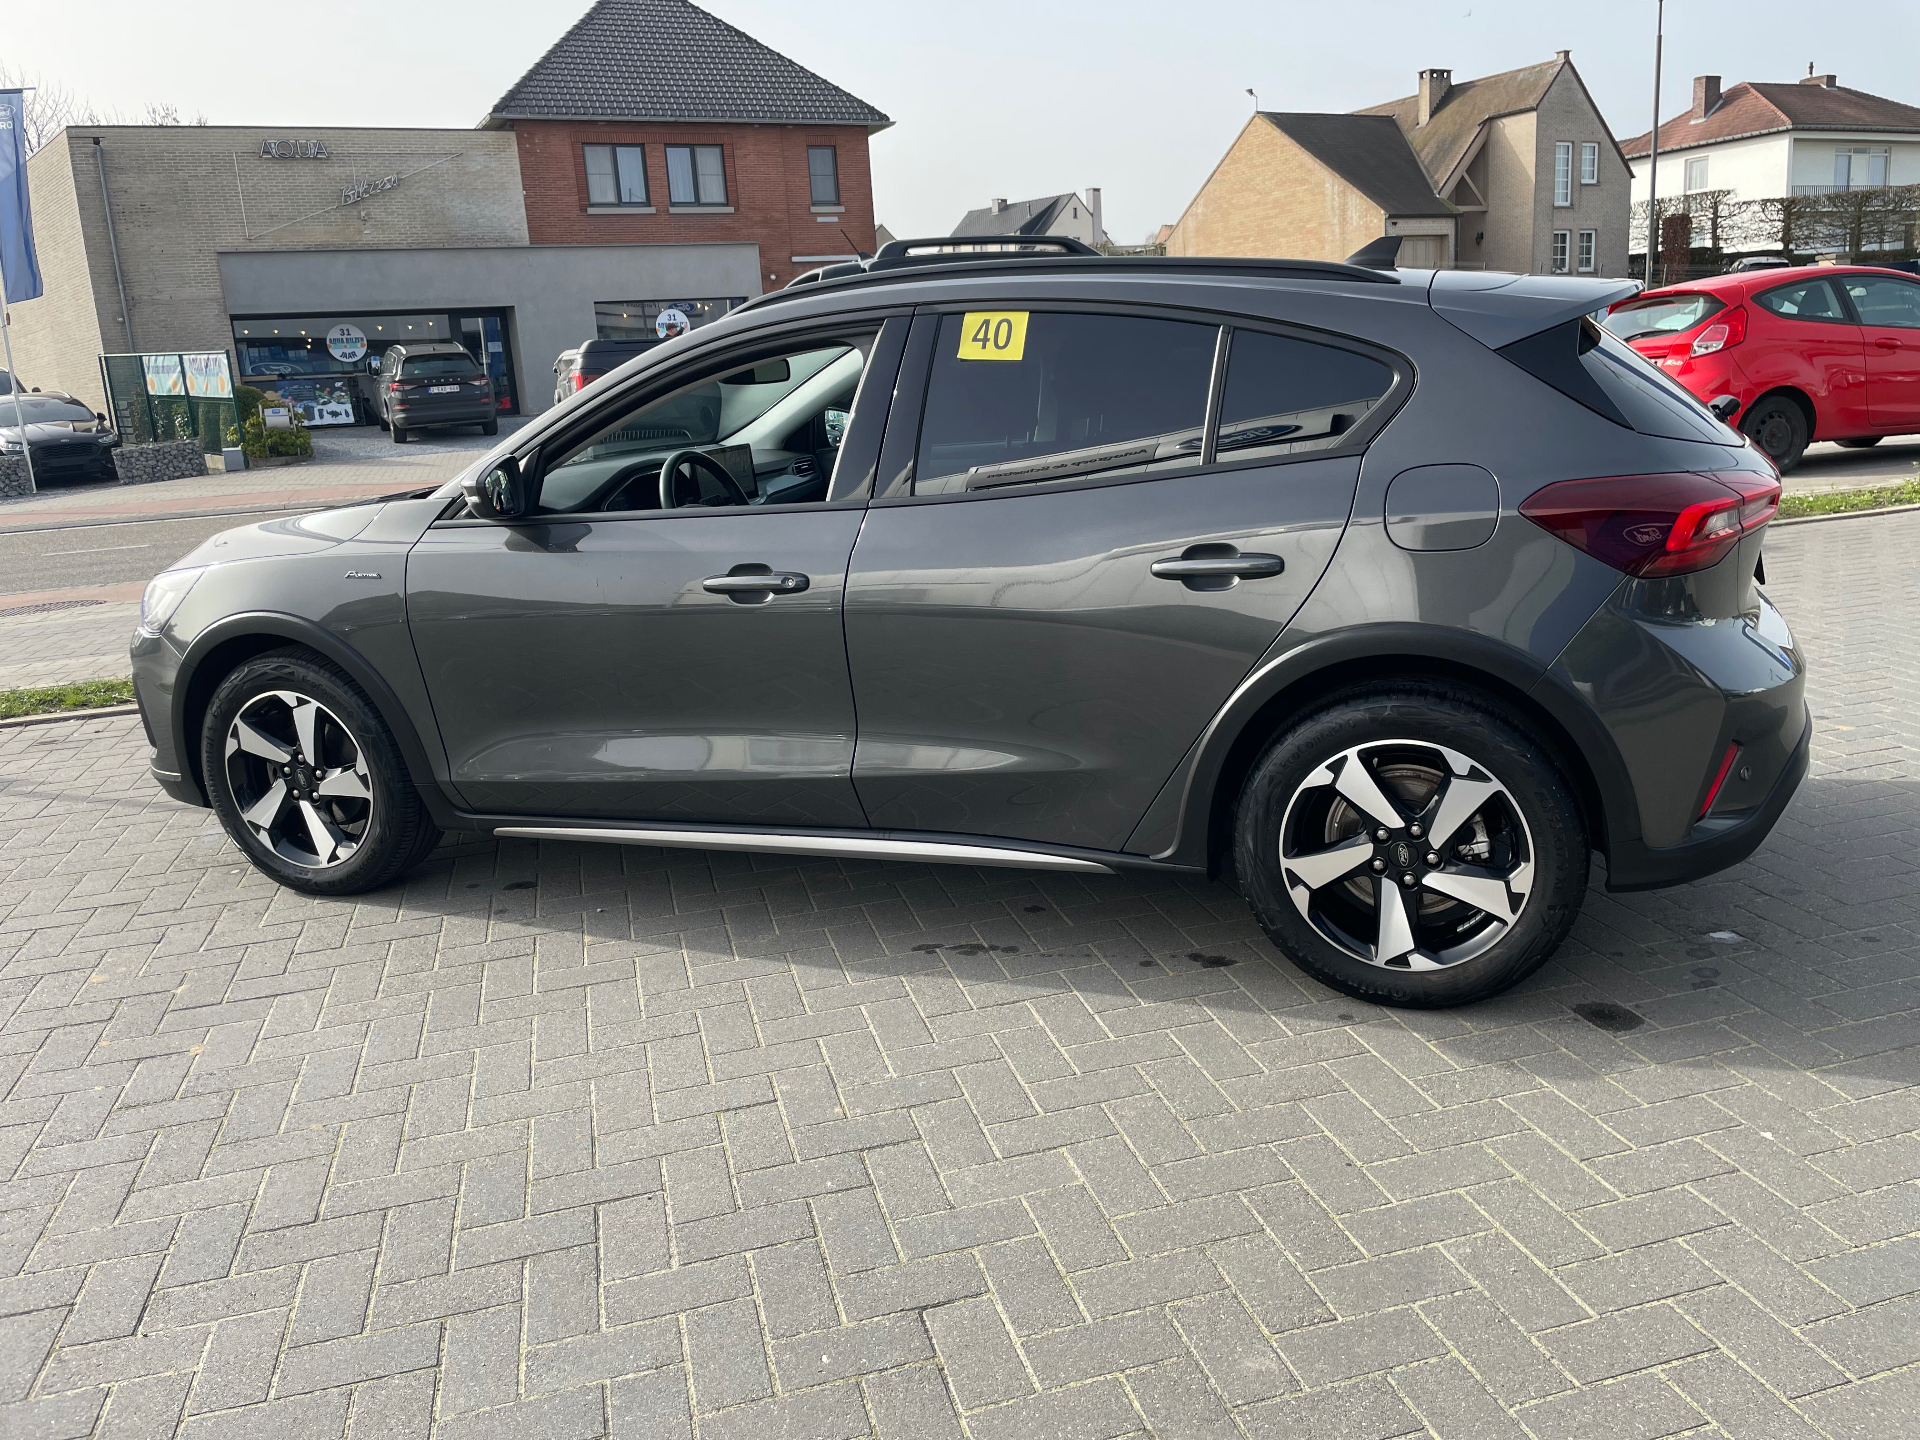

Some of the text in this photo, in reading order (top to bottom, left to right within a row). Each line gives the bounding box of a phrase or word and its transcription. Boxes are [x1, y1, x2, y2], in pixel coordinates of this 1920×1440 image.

[259, 139, 330, 158] AQUA
[339, 328, 351, 336] 31
[971, 318, 1013, 350] 40
[339, 351, 358, 360] JAAR
